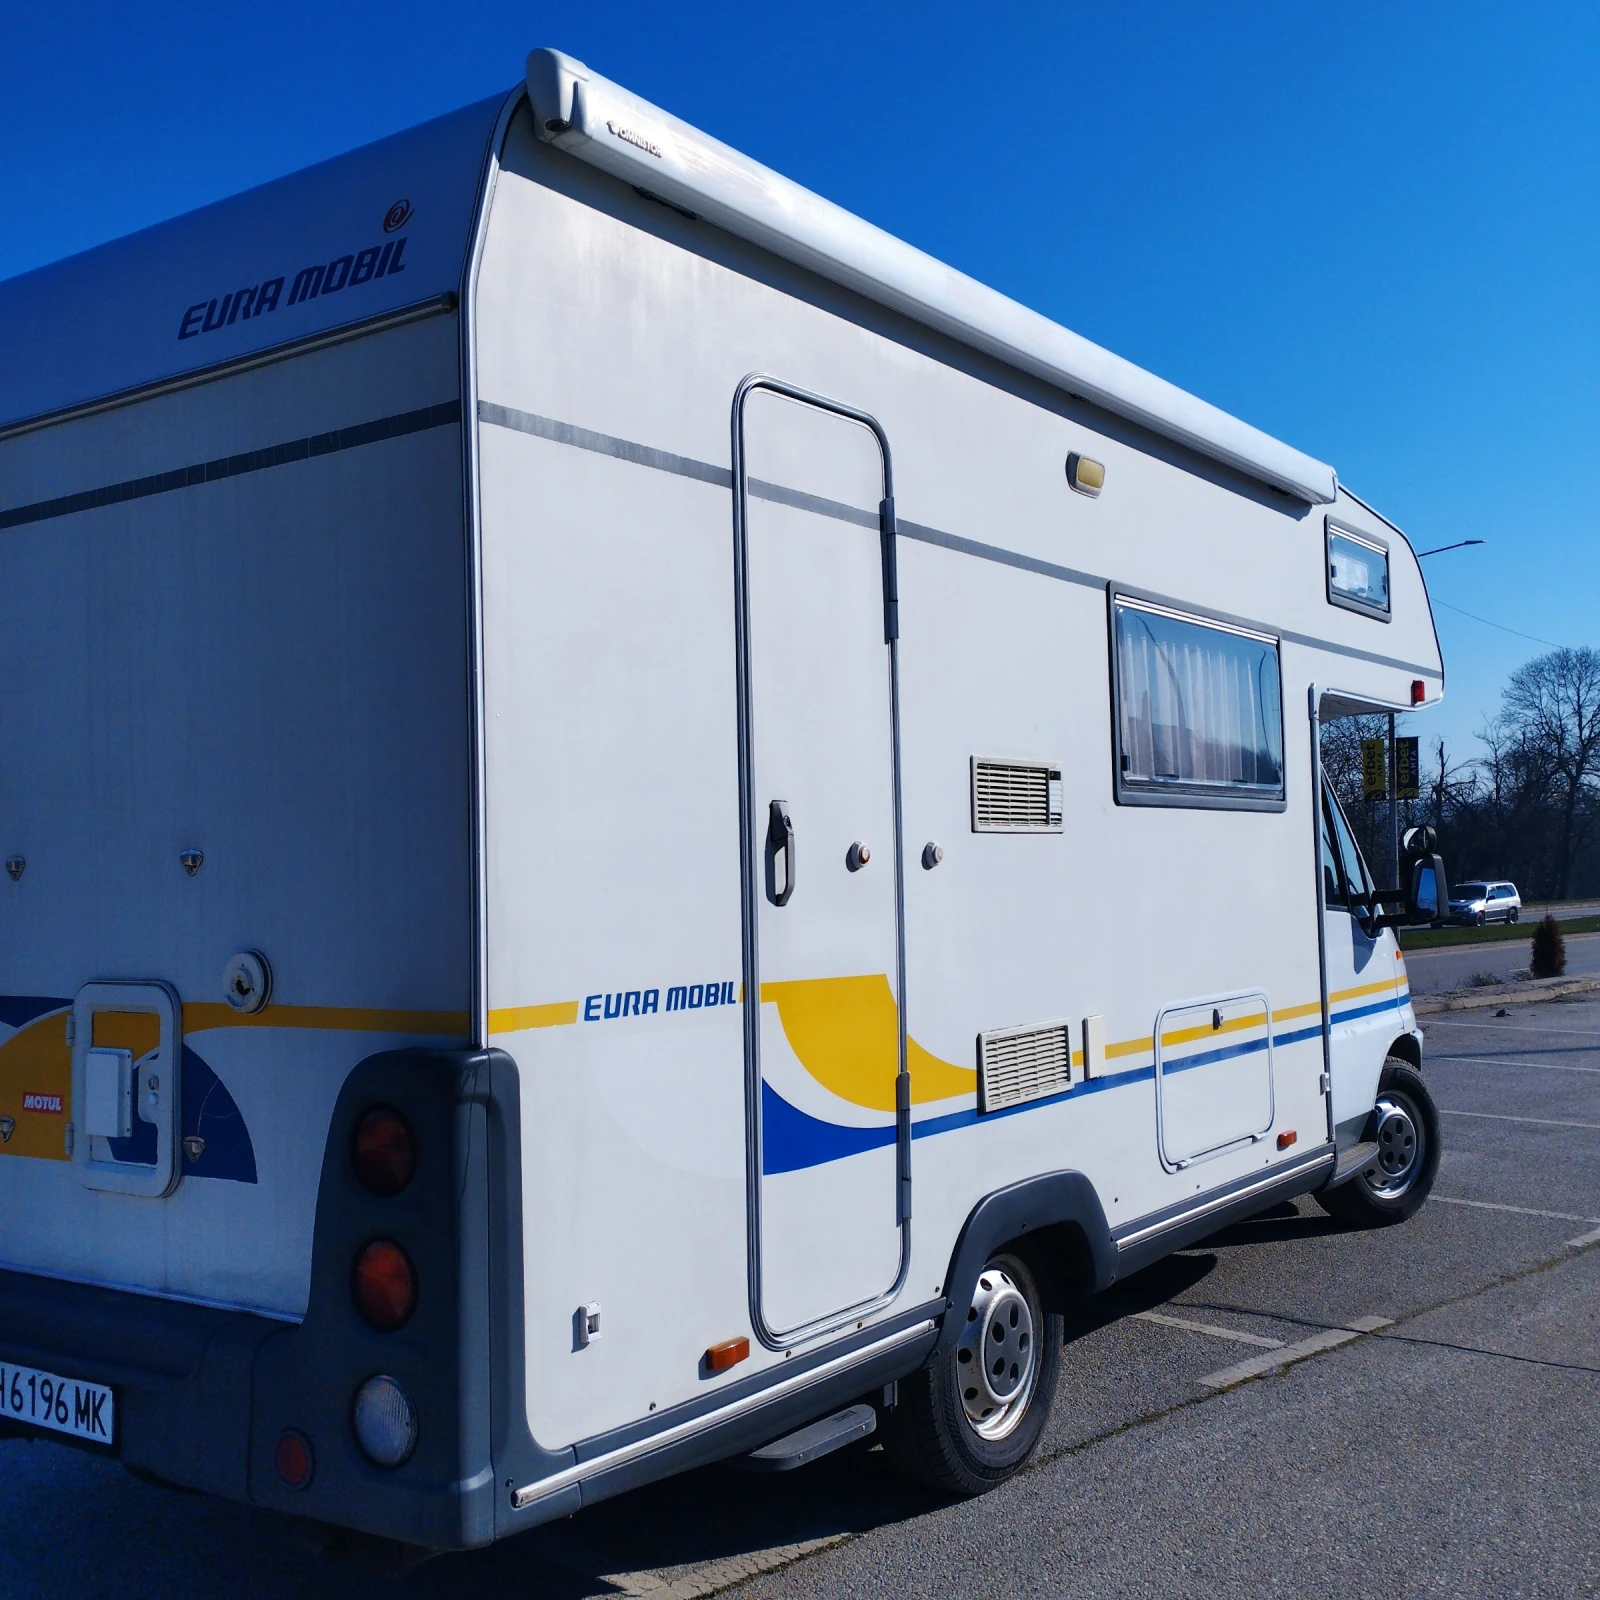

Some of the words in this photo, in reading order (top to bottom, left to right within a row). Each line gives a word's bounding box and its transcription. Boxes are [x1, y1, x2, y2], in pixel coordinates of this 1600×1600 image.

[617, 127, 662, 158] OMNISTOR
[177, 276, 285, 341] EURA
[287, 237, 408, 307] MOBIL
[1366, 743, 1376, 786] efbet
[1399, 741, 1409, 784] efbet
[584, 989, 660, 1021] EURA
[665, 981, 736, 1012] MOBIL
[23, 1095, 62, 1112] MOTUL
